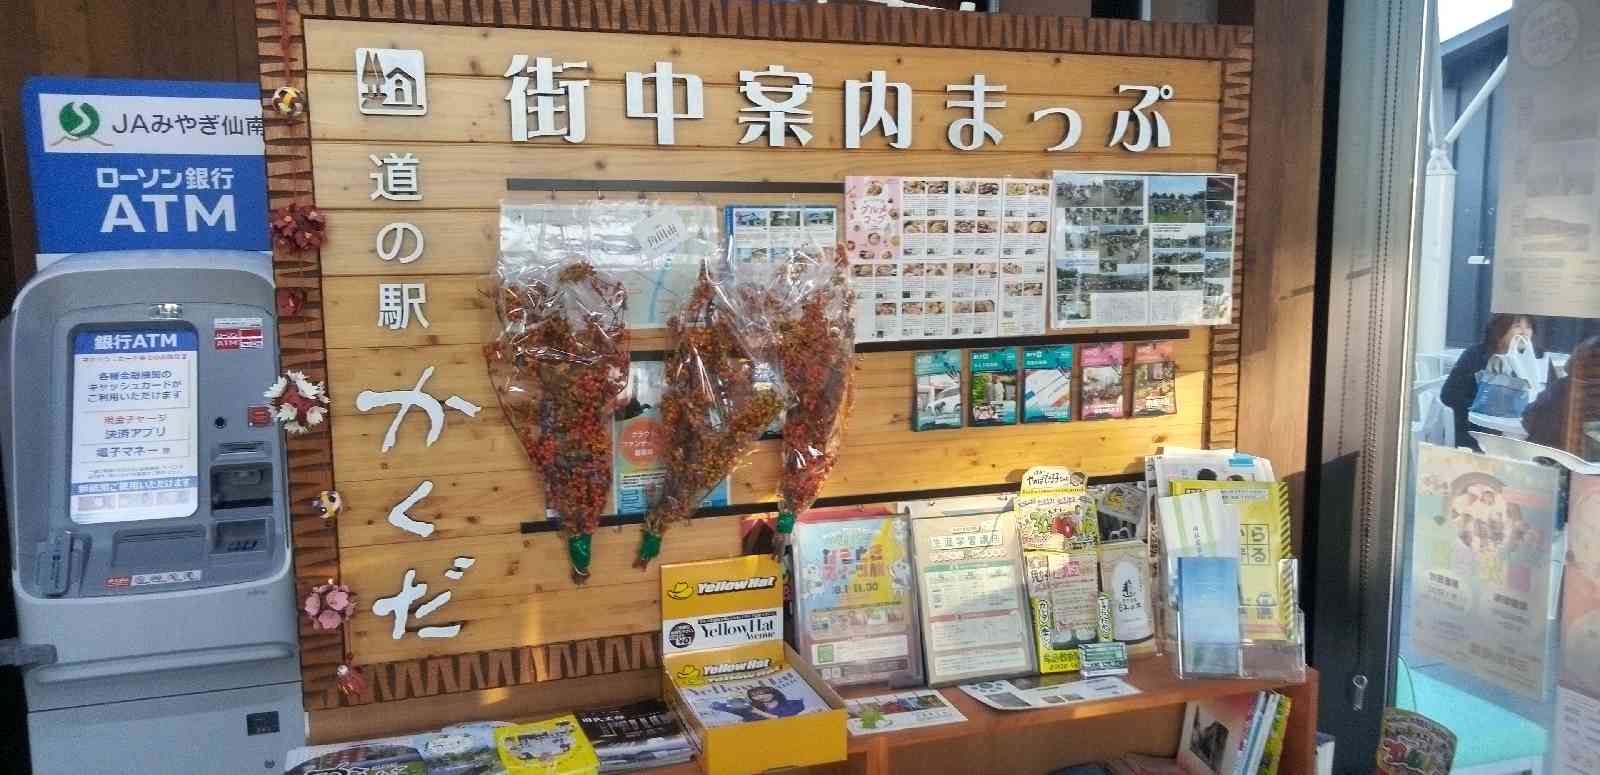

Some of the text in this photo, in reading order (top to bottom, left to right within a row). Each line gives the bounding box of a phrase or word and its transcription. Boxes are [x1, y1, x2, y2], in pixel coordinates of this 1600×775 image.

[504, 54, 1175, 153] 街中案内まっぷ
[112, 113, 264, 136] JAみやぎ仙南
[96, 167, 235, 190] ローソン銀行
[100, 194, 237, 233] ATM
[94, 333, 178, 351] 銀行ATM
[356, 152, 482, 640] 道の駅 かくだ
